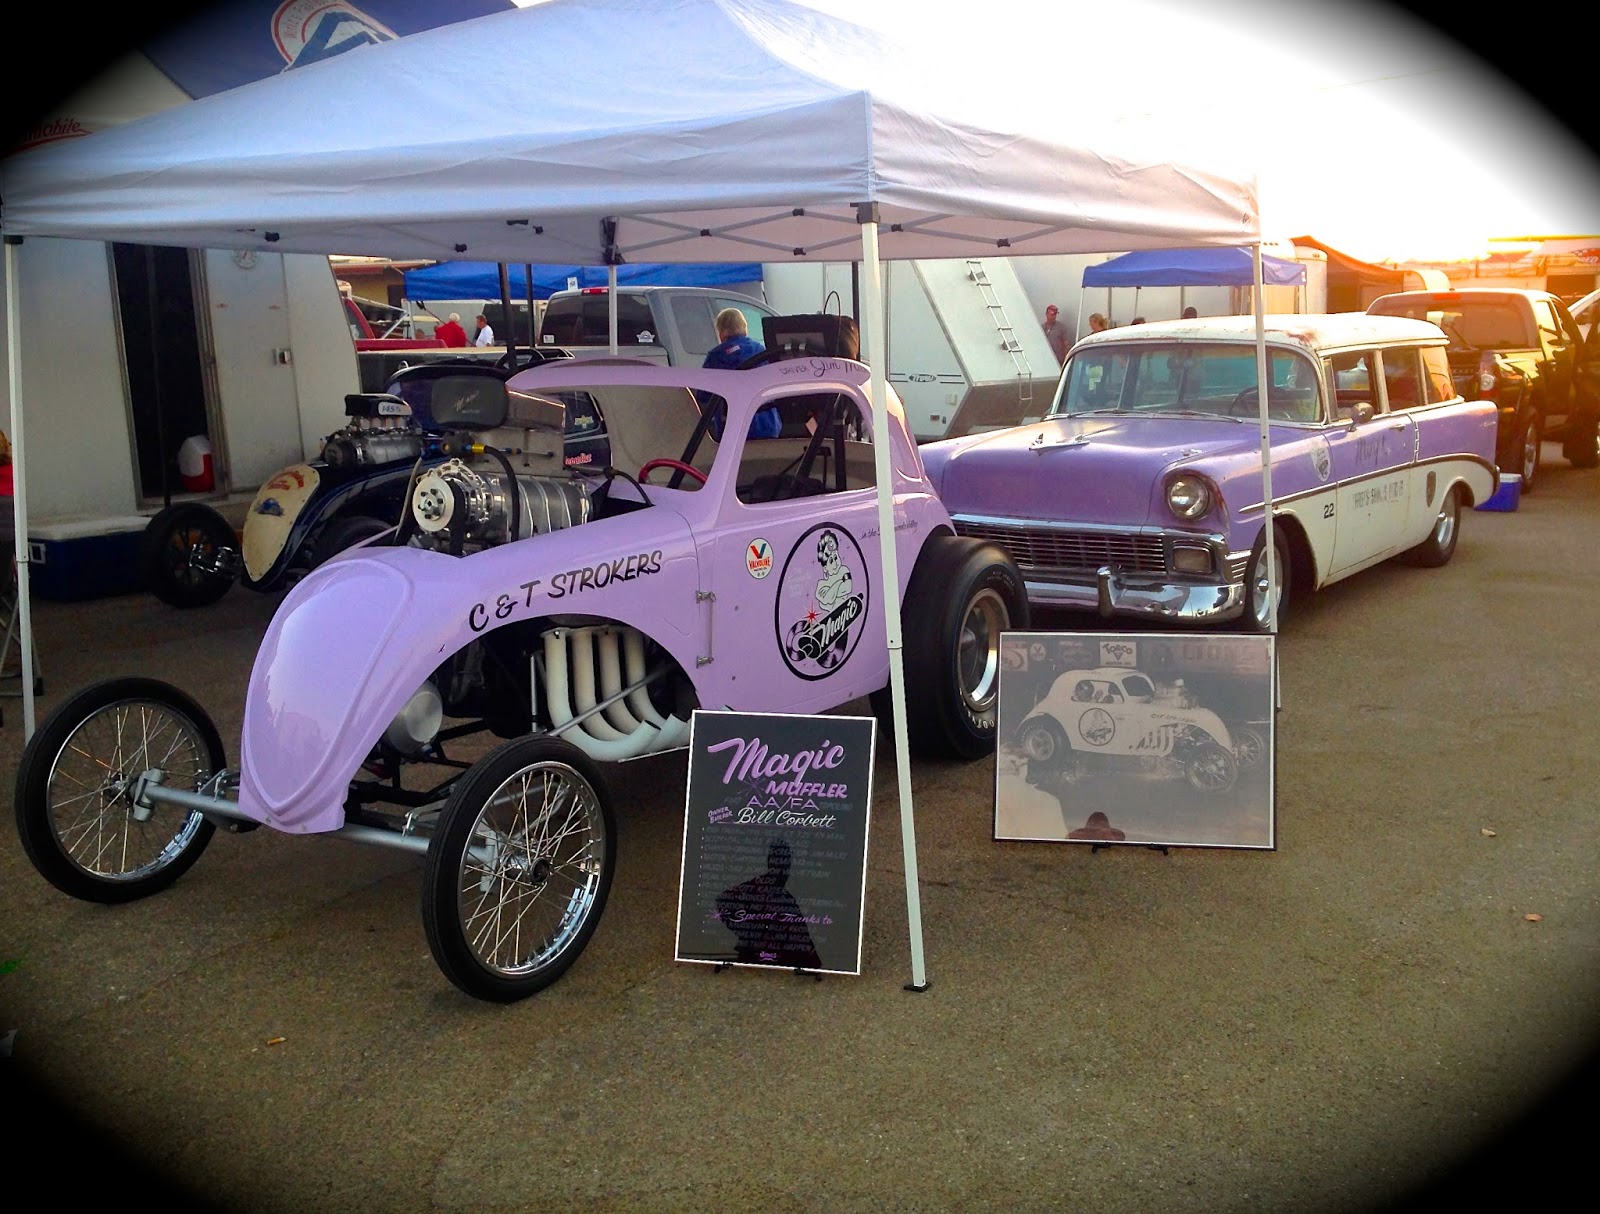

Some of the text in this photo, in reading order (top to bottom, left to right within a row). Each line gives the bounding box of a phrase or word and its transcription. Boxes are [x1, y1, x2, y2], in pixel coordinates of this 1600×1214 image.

[1323, 503, 1335, 520] 22
[468, 550, 663, 632] C & T STROKERS
[808, 599, 858, 648] Magic
[1102, 642, 1133, 655] TORCO
[707, 737, 847, 786] Magic
[765, 780, 848, 799] MUFFLER
[734, 806, 837, 828] Bill Corbett
[729, 909, 833, 925] Special Thanks to
